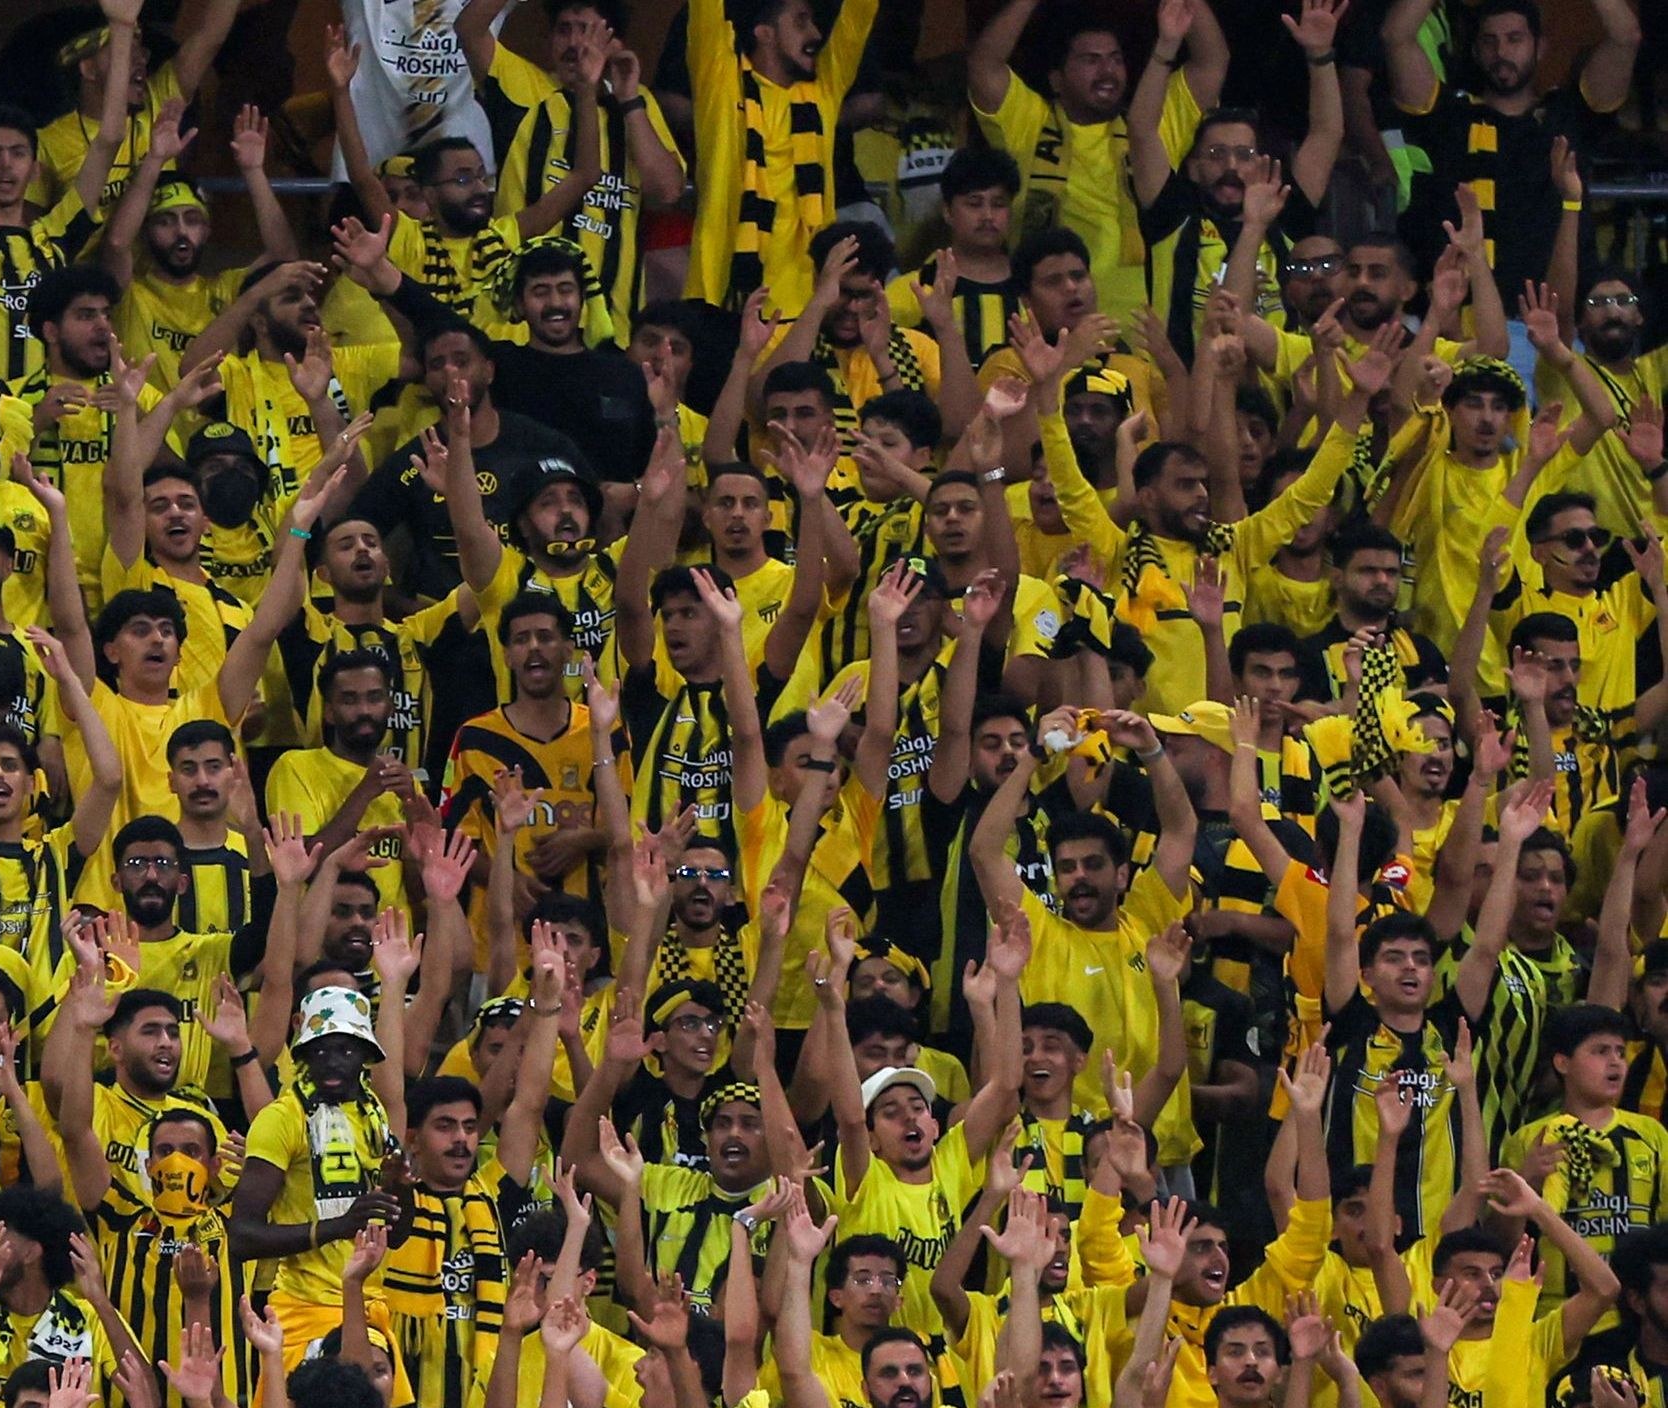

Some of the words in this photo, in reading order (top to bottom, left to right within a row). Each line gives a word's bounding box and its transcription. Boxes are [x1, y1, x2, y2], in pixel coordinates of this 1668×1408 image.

[398, 55, 459, 76] ROSHN
[583, 190, 621, 210] SHN
[887, 756, 934, 779] OSHN
[889, 787, 923, 807] sur
[1575, 1217, 1631, 1237] OSHN
